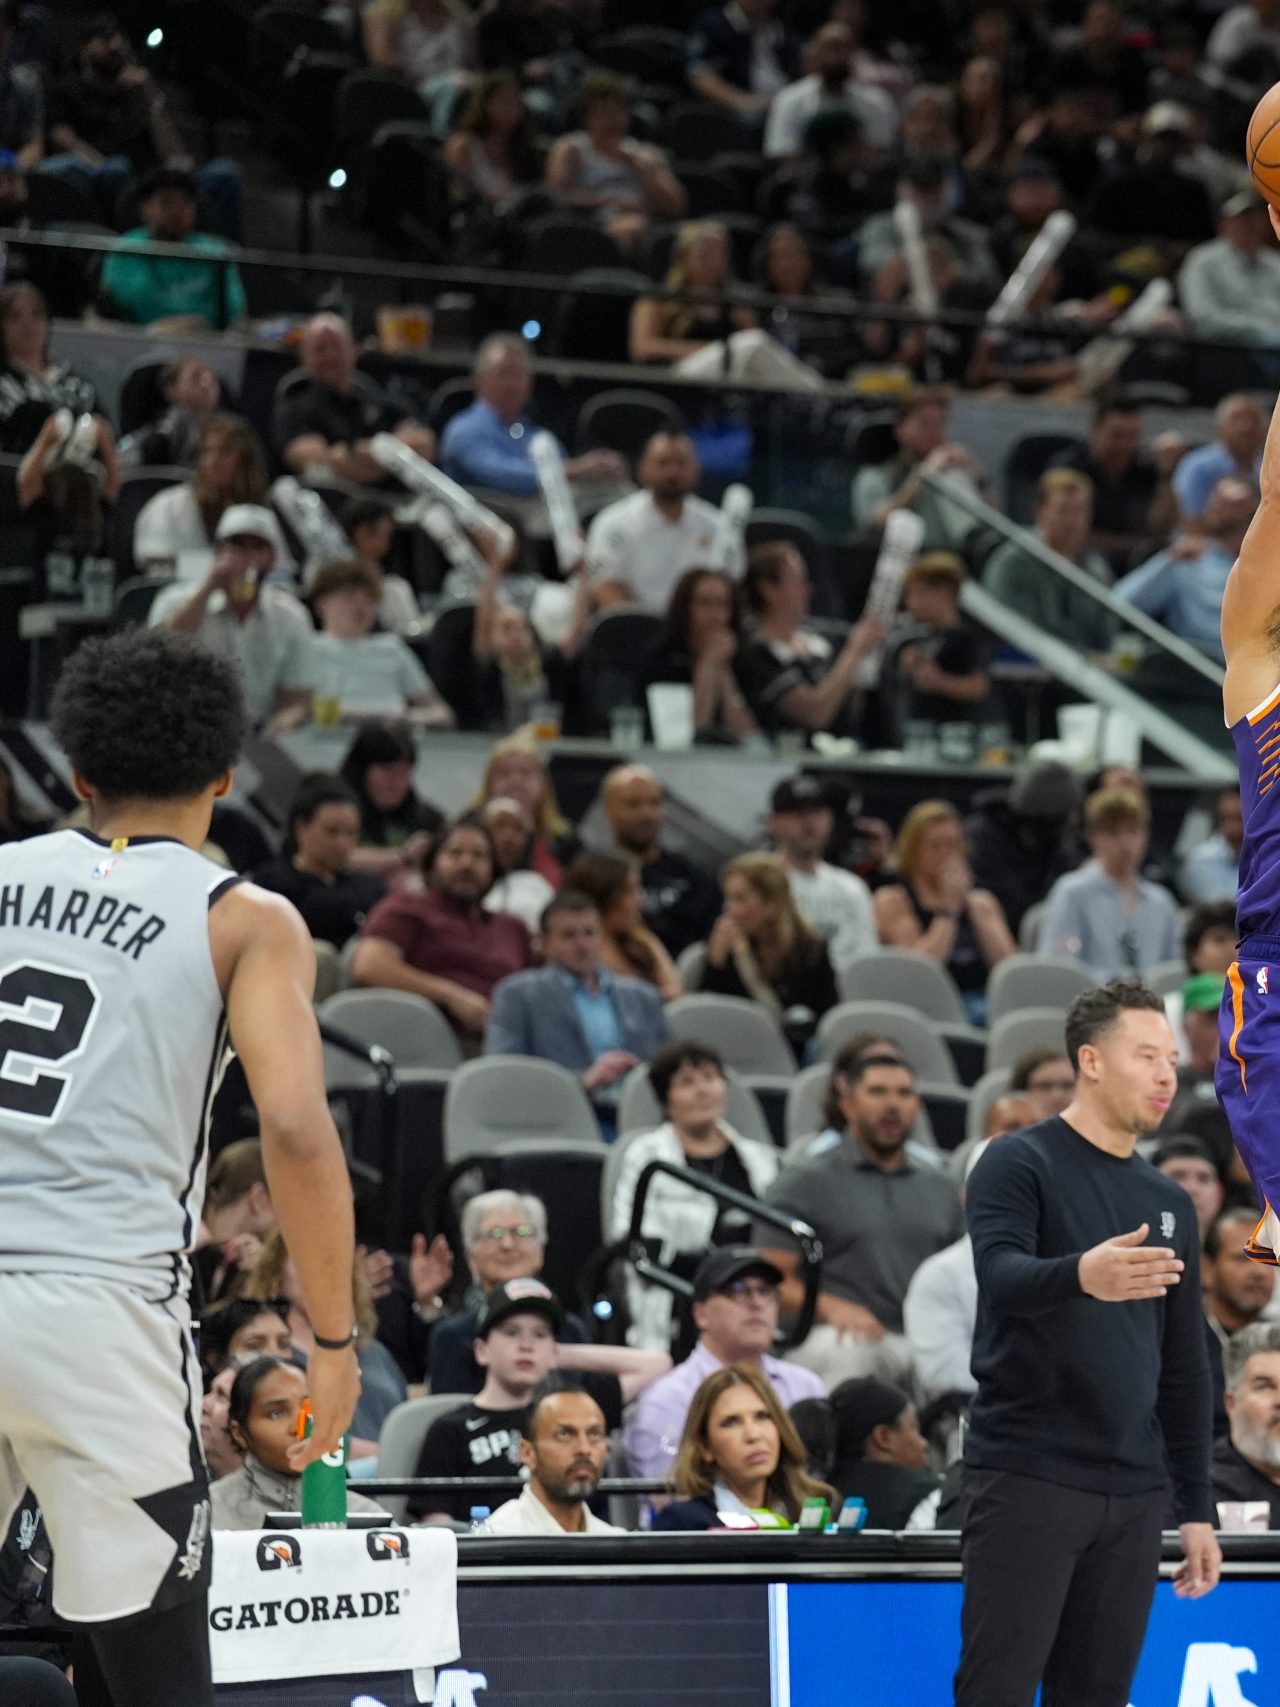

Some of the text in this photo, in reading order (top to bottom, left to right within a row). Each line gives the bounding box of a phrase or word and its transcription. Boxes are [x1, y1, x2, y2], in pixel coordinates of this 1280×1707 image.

[0, 884, 166, 960] HARPER
[0, 959, 102, 1125] 2
[209, 1590, 400, 1632] GATORADE
